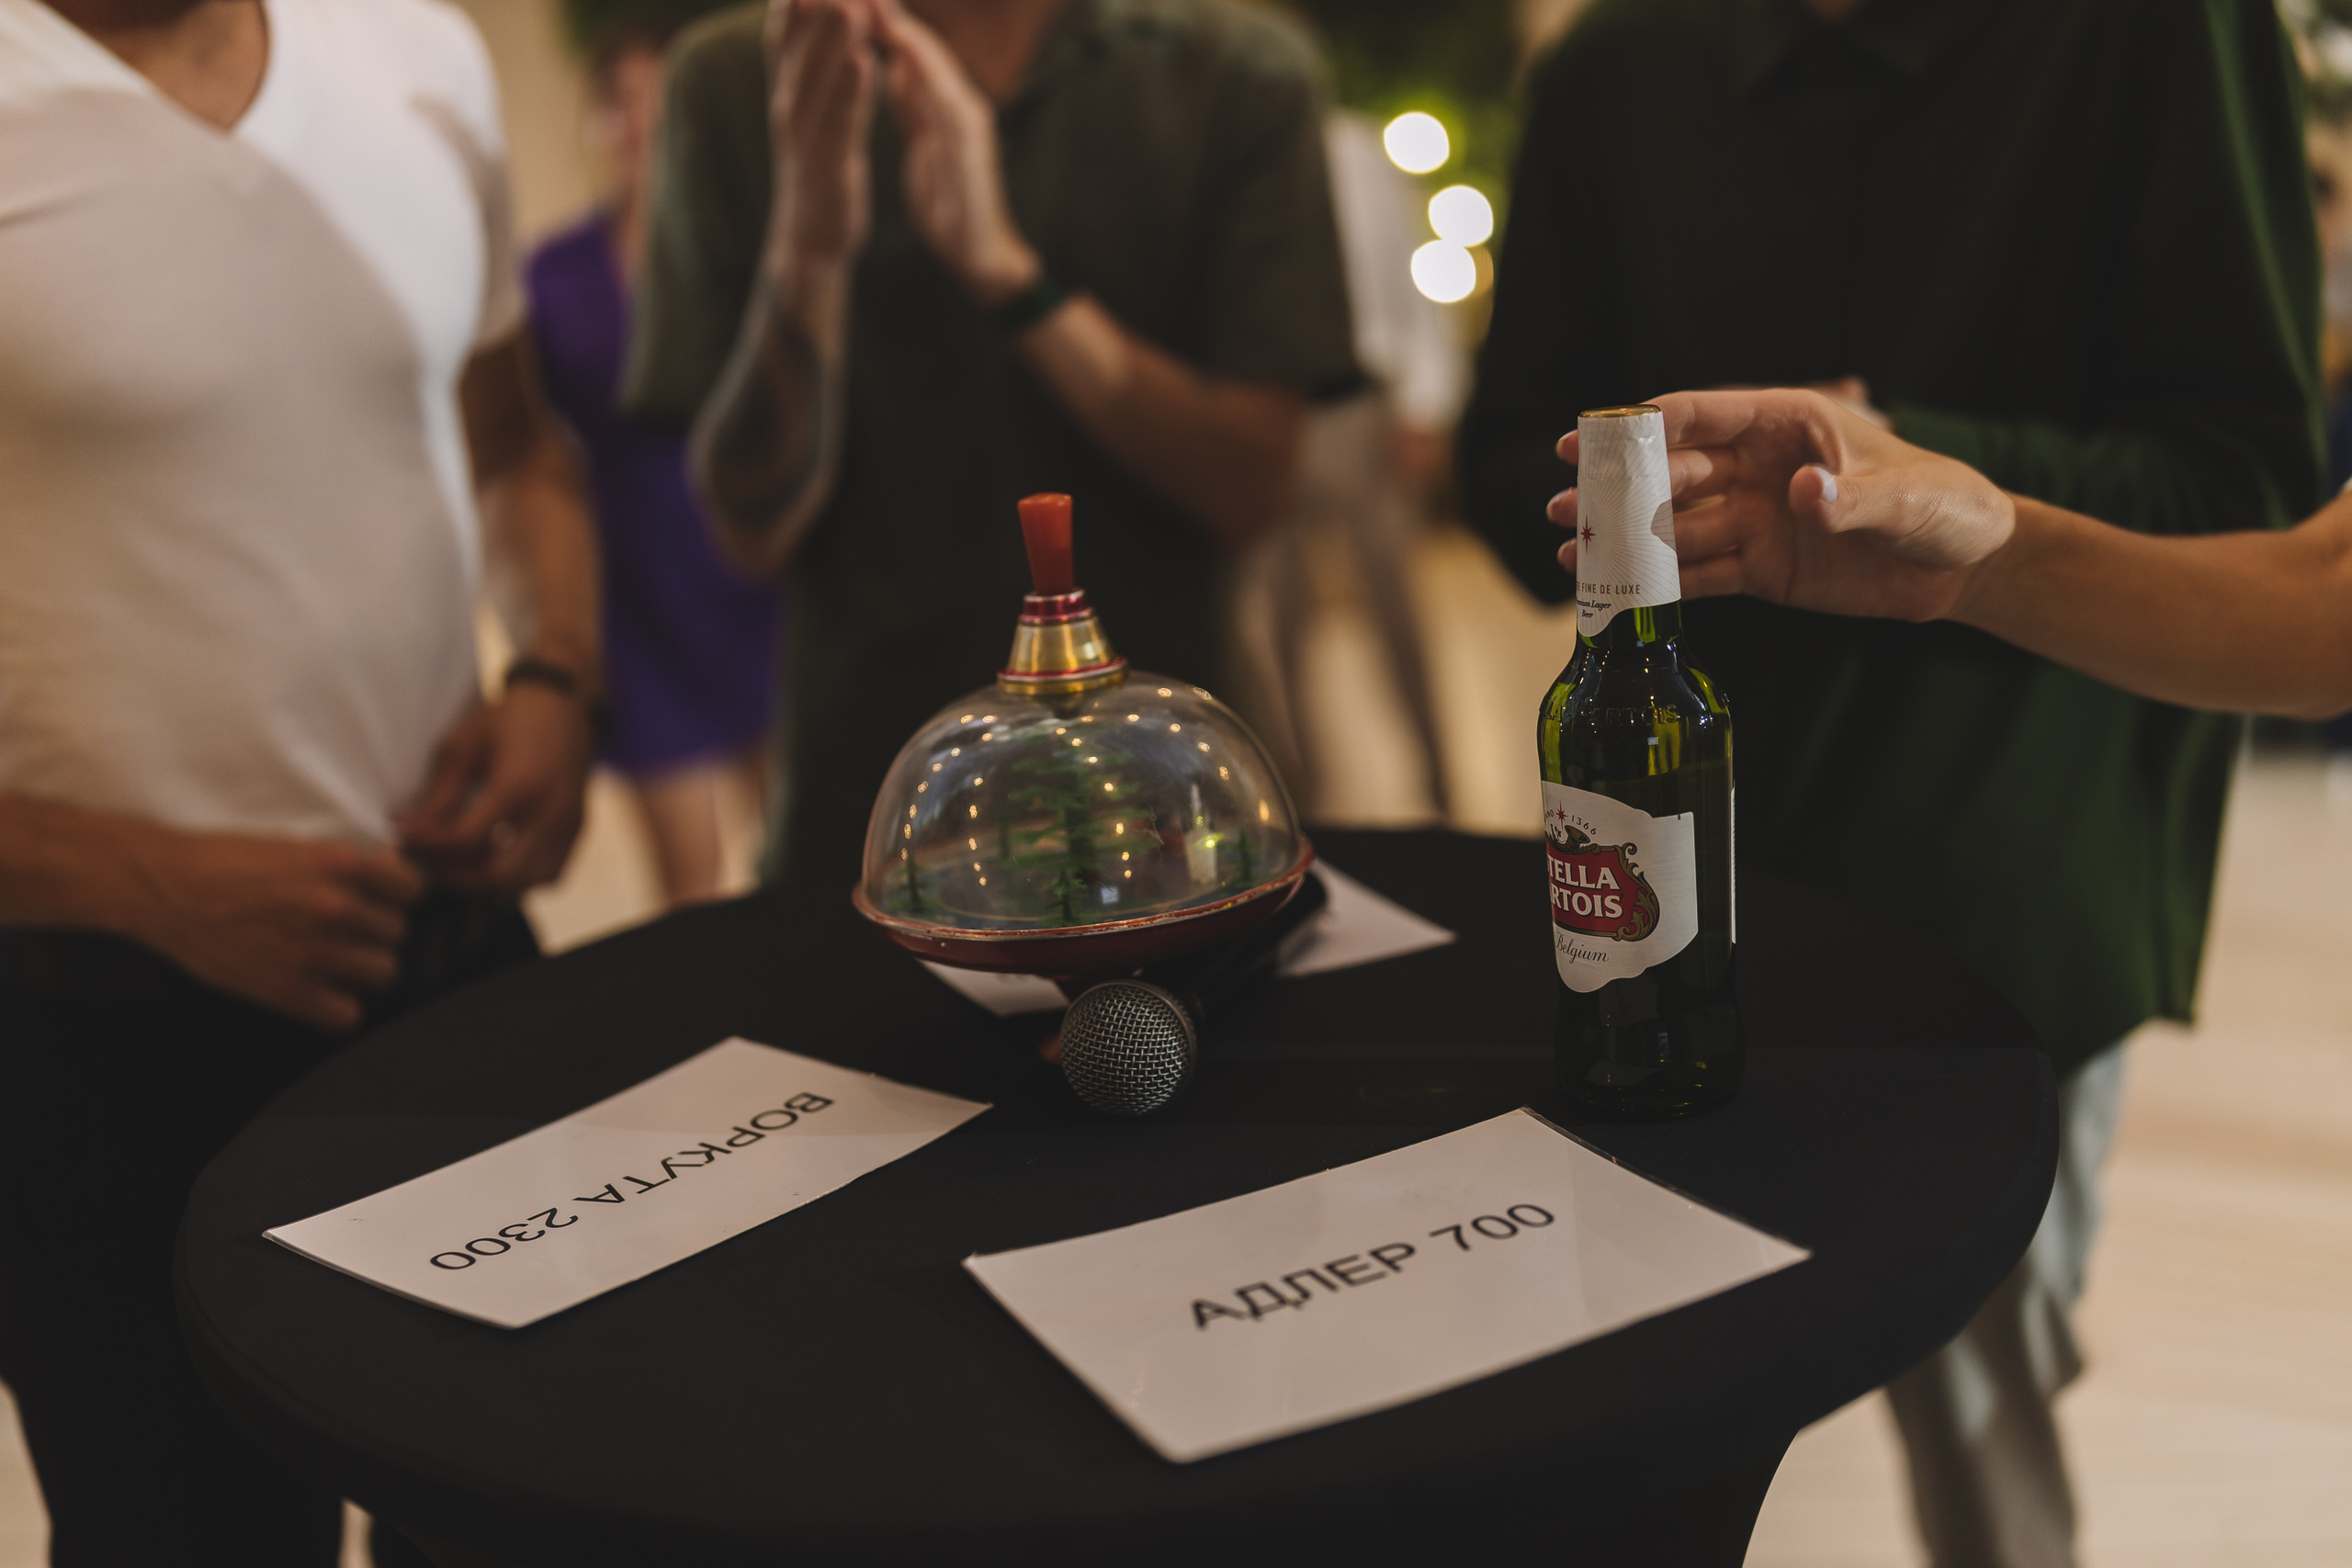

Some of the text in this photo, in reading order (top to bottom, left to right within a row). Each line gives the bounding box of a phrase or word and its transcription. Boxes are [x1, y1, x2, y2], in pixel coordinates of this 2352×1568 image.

[1582, 582, 1597, 594] FINE
[1600, 584, 1611, 595] DE
[1615, 584, 1641, 595] LUXE
[1581, 608, 1594, 619] Beer
[1590, 599, 1612, 612] Lager
[1571, 814, 1597, 836] 1366
[1546, 852, 1621, 890] TELLA
[1550, 882, 1623, 919] RTOIS
[1555, 931, 1610, 964] Belgium
[429, 1091, 835, 1271] ВОРКУТА 2300
[1191, 1203, 1555, 1331] АДЛЕР 700
